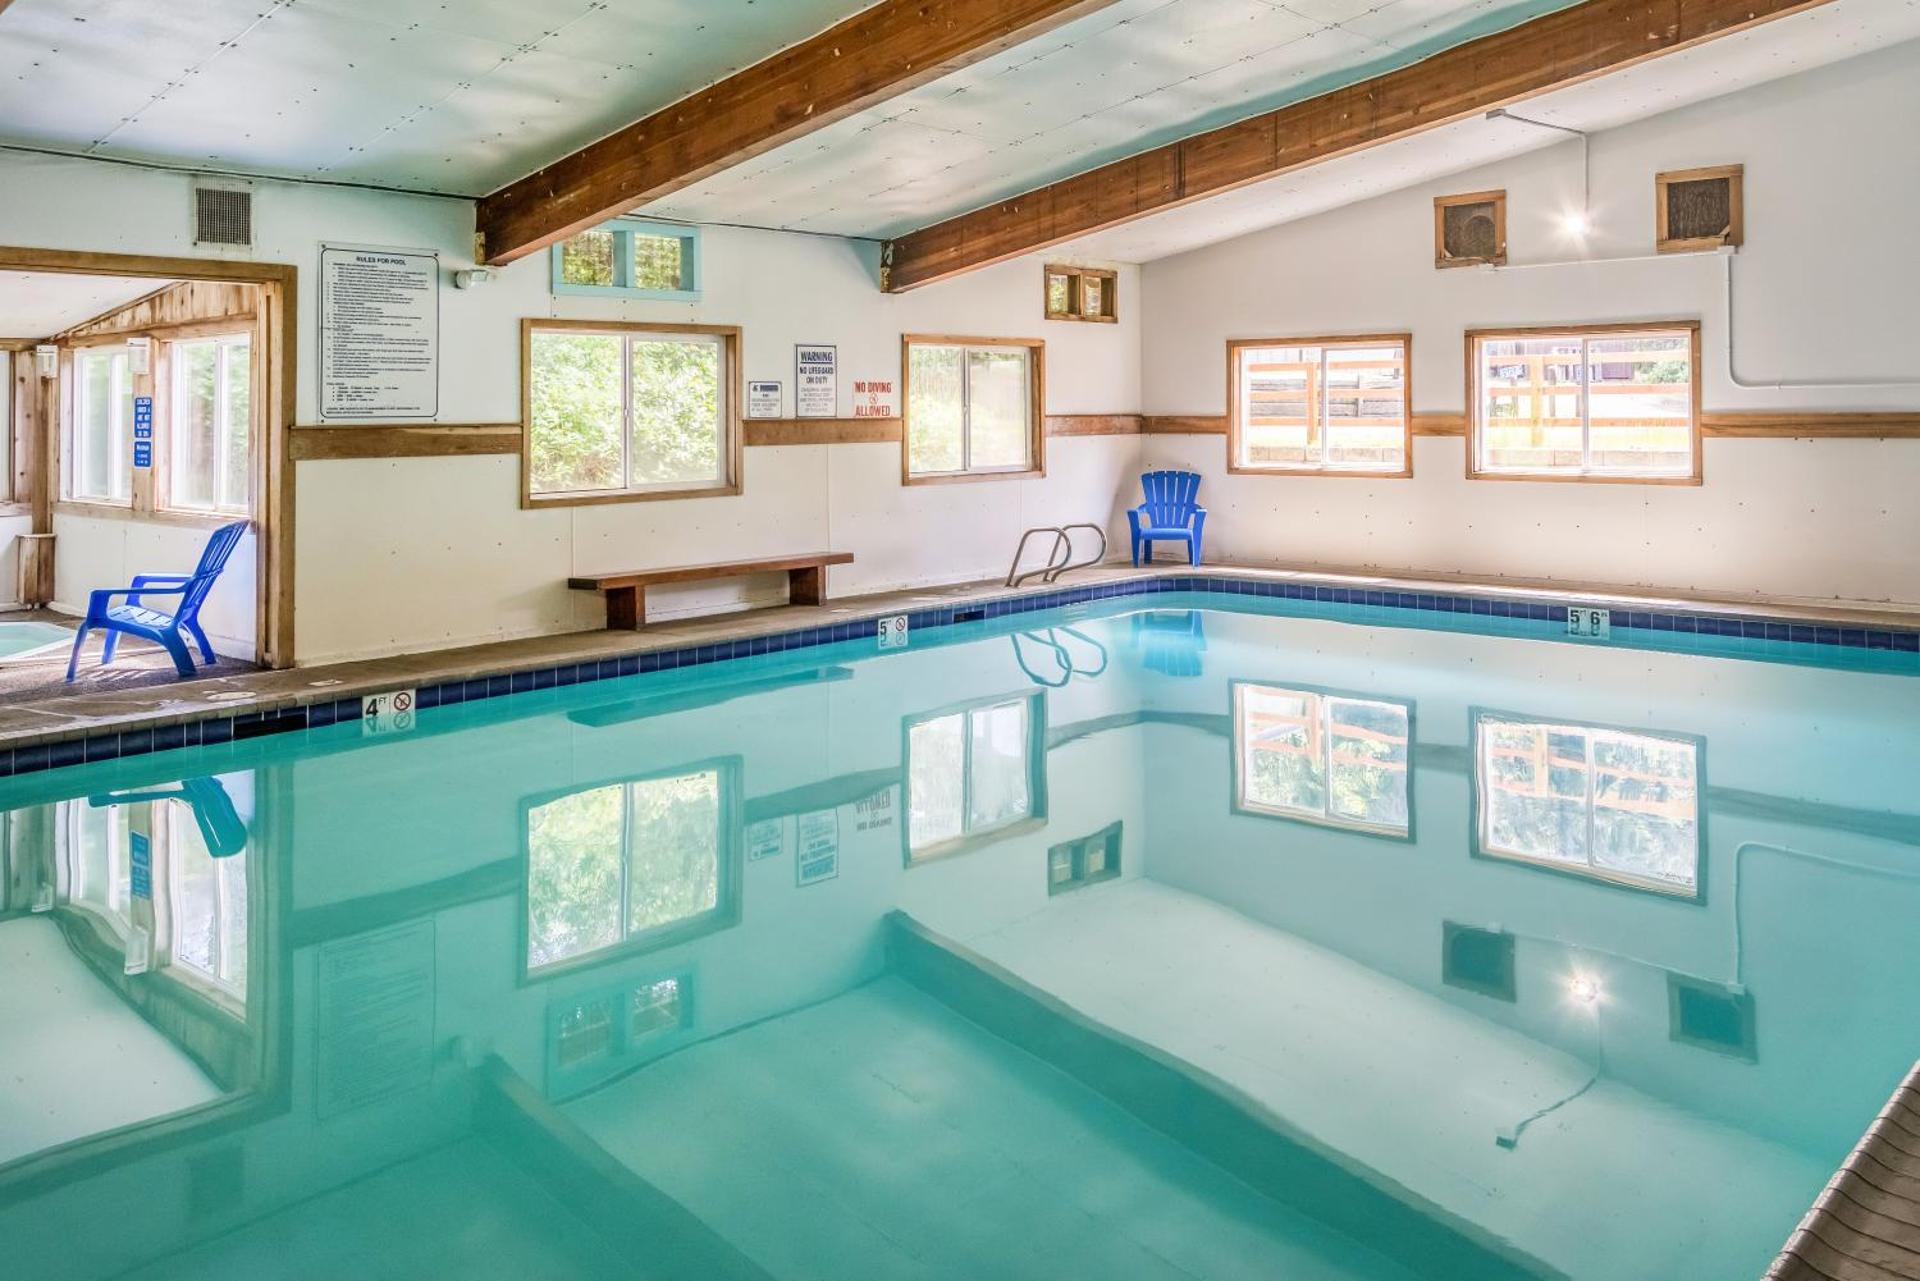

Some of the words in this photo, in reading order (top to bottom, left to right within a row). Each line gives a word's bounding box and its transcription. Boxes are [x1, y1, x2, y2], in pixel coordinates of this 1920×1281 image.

[800, 351, 833, 361] WARNING
[800, 366, 807, 374] NO
[854, 382, 866, 393] NO
[867, 382, 892, 393] DIVING
[855, 405, 891, 417] ALLOWED
[1570, 610, 1580, 623] 5
[1590, 611, 1600, 625] 6
[880, 621, 887, 634] 5
[366, 698, 378, 716] 4
